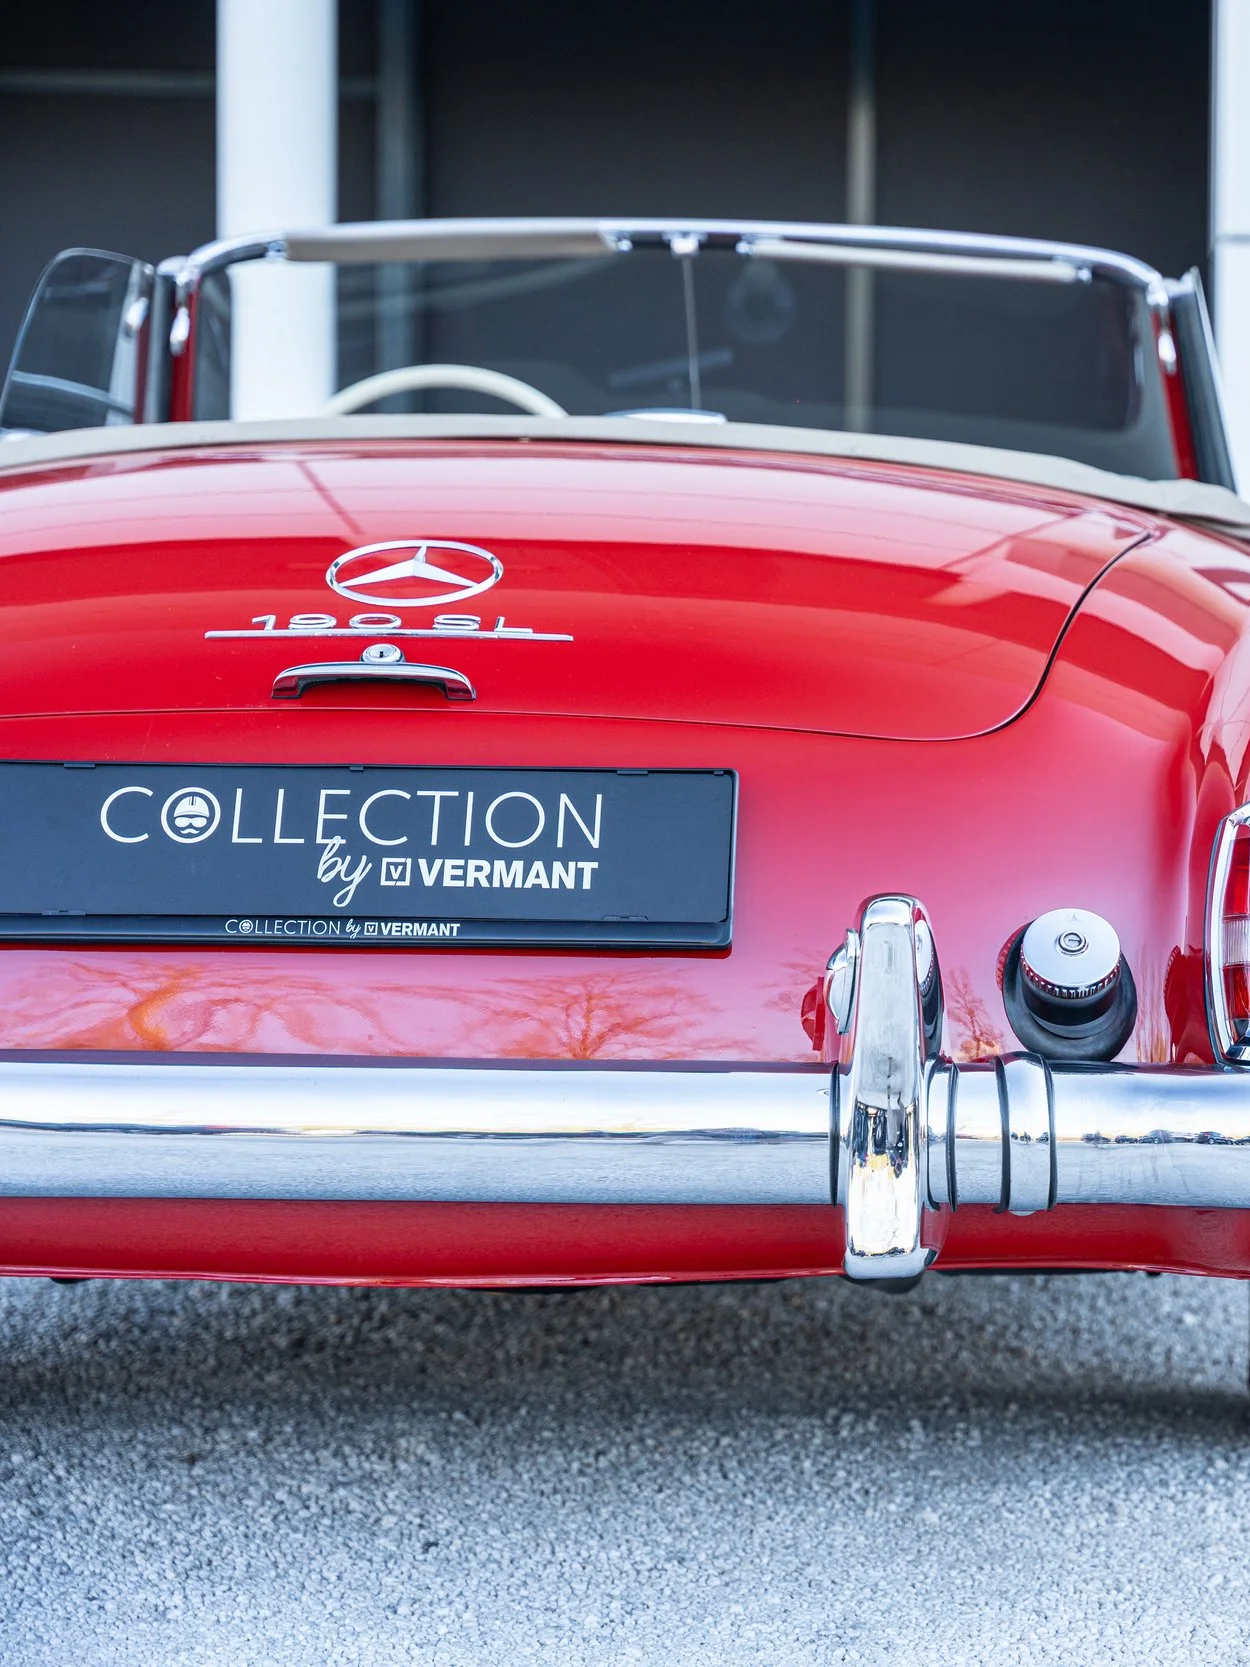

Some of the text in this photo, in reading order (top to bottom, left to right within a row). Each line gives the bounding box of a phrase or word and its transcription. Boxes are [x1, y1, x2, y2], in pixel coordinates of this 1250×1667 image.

[251, 613, 533, 634] 190 SL
[100, 785, 603, 849] COLLECTION
[317, 835, 373, 908] by
[417, 858, 599, 890] VERMANT
[225, 919, 341, 935] COLLECTION
[345, 918, 362, 939] by
[380, 922, 461, 936] VERMANT
